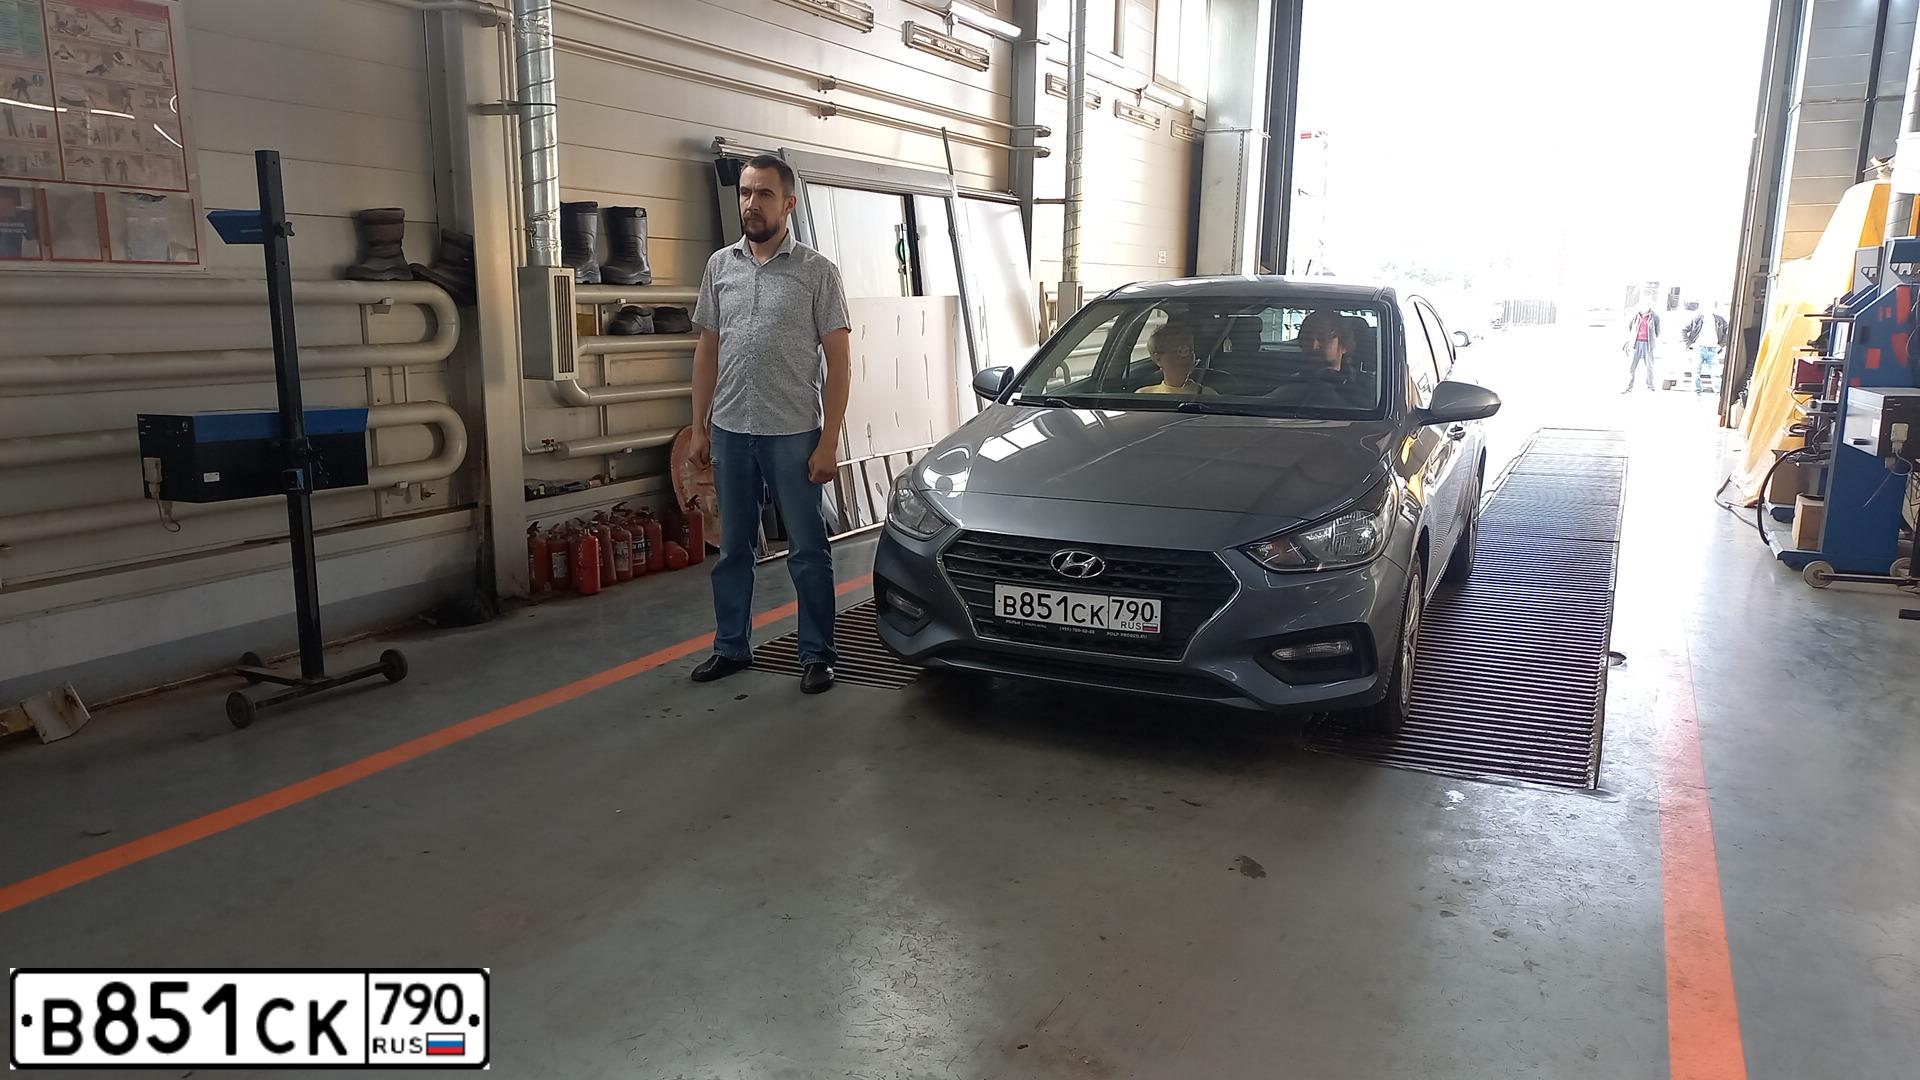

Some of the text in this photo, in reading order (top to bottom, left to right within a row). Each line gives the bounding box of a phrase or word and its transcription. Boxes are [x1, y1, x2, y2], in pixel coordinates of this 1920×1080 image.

[1003, 592, 1154, 626] В851СК 790
[1120, 621, 1142, 631] RUS
